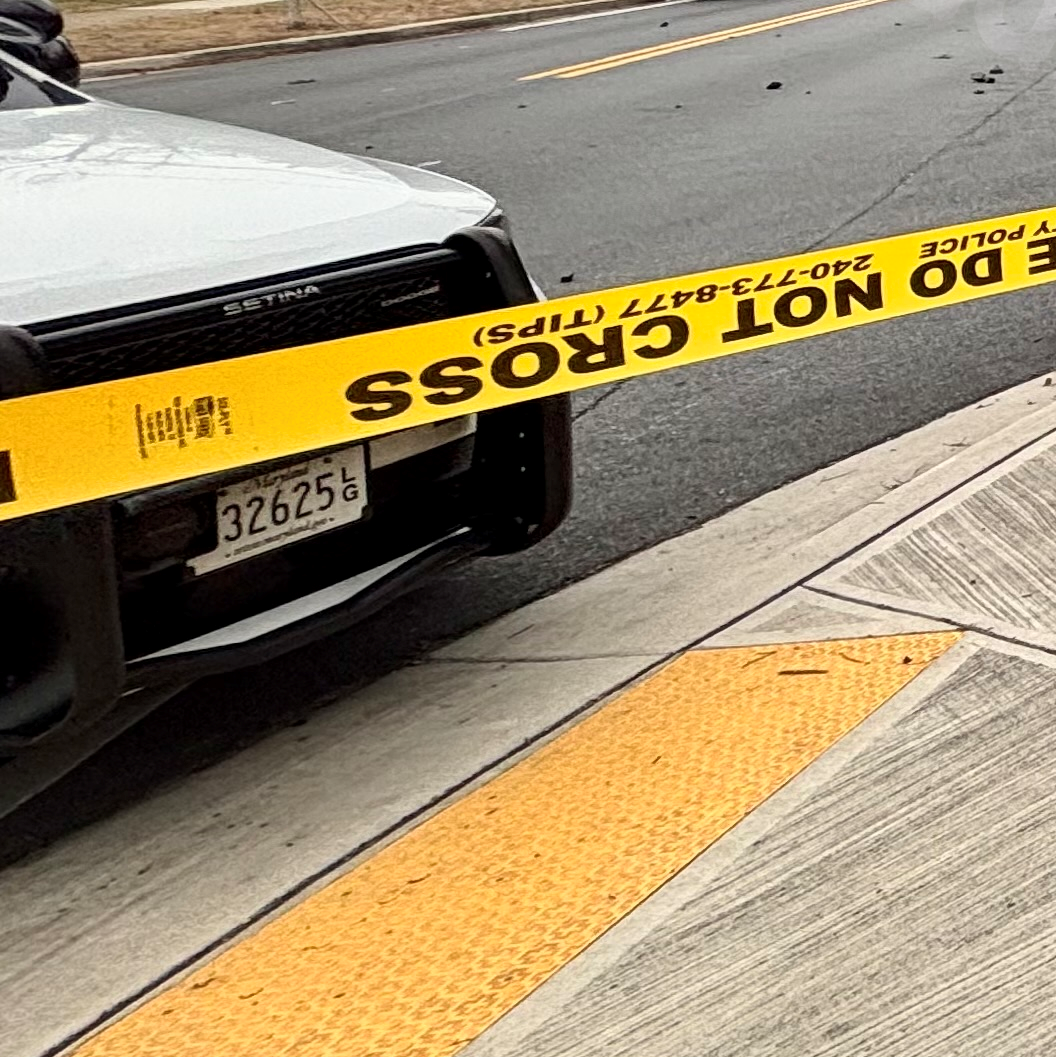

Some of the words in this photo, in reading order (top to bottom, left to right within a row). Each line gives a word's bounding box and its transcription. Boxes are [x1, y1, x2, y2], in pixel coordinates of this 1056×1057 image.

[910, 247, 1003, 297] DO
[919, 225, 1026, 258] POLICE
[618, 254, 874, 320] 240-773-8477
[721, 272, 884, 343] NOT
[473, 305, 605, 348] (TIPS)
[345, 315, 689, 422] CROSS
[222, 472, 334, 542] 32625
